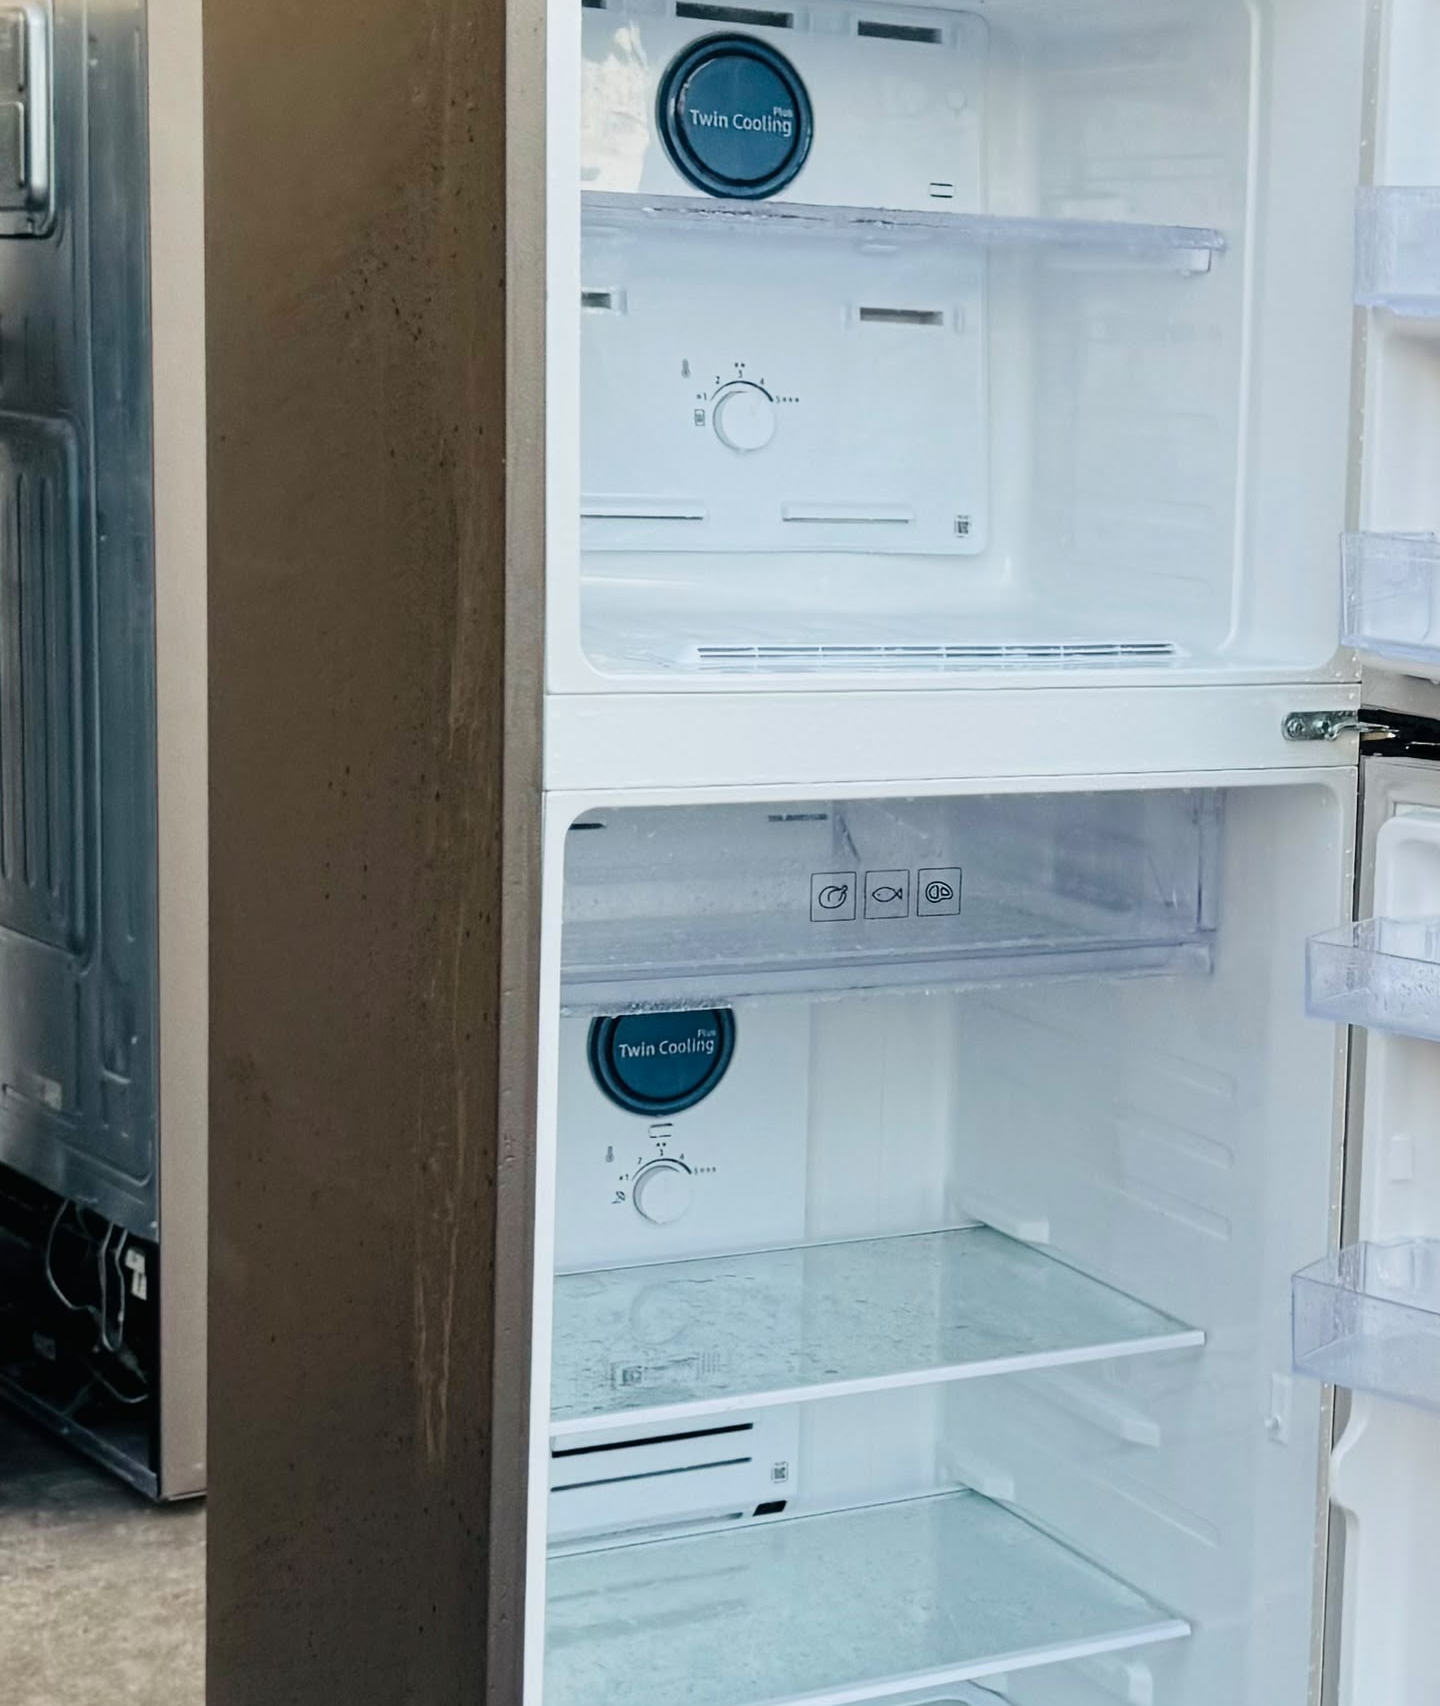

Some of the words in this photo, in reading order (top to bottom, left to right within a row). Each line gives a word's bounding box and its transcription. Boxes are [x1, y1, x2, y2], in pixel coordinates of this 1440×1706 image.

[689, 108, 729, 129] Twin
[732, 113, 792, 137] Cooling
[619, 1041, 655, 1058] Twin
[659, 1038, 714, 1055] Cooling
